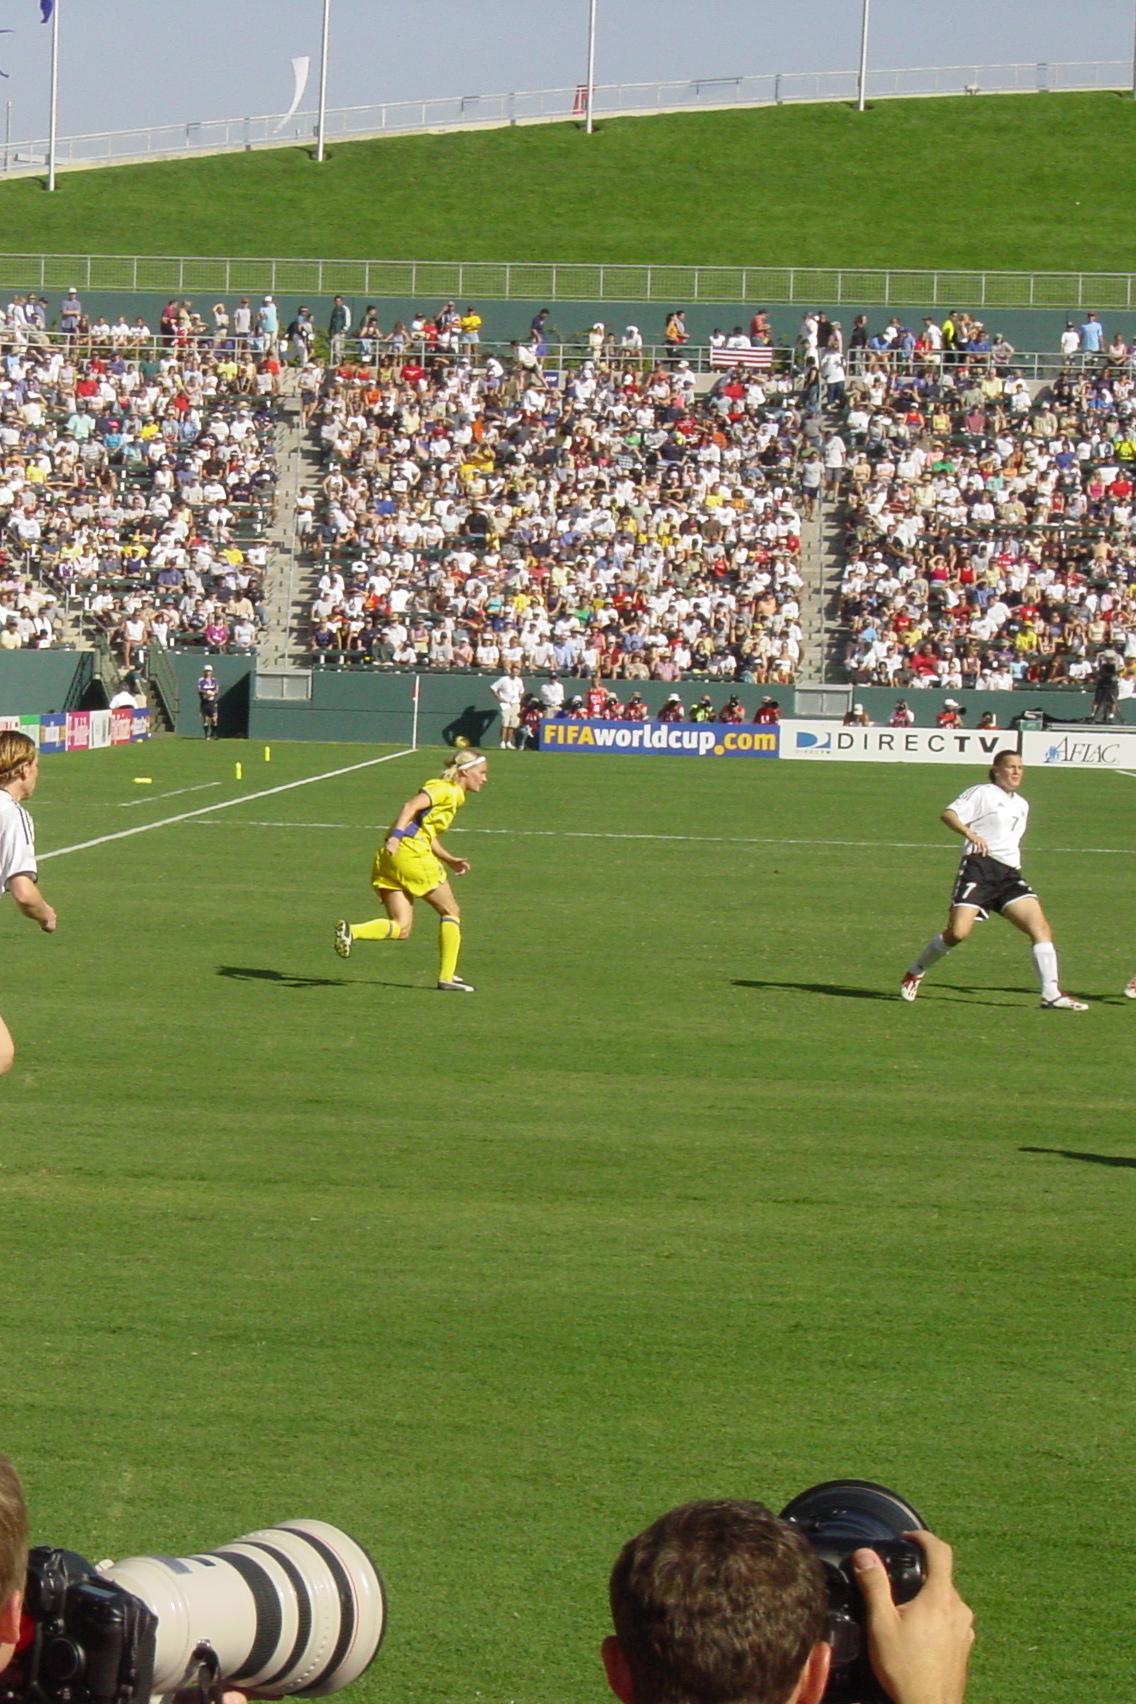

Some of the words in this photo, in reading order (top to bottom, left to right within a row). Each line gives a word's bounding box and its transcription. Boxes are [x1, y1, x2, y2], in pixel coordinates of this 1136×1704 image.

[543, 723, 776, 756] FIFAworldcup.com
[837, 732, 1000, 753] DIRECTV
[1044, 736, 1120, 763] AFLAC
[1010, 815, 1020, 832] 7
[962, 882, 977, 899] 7
